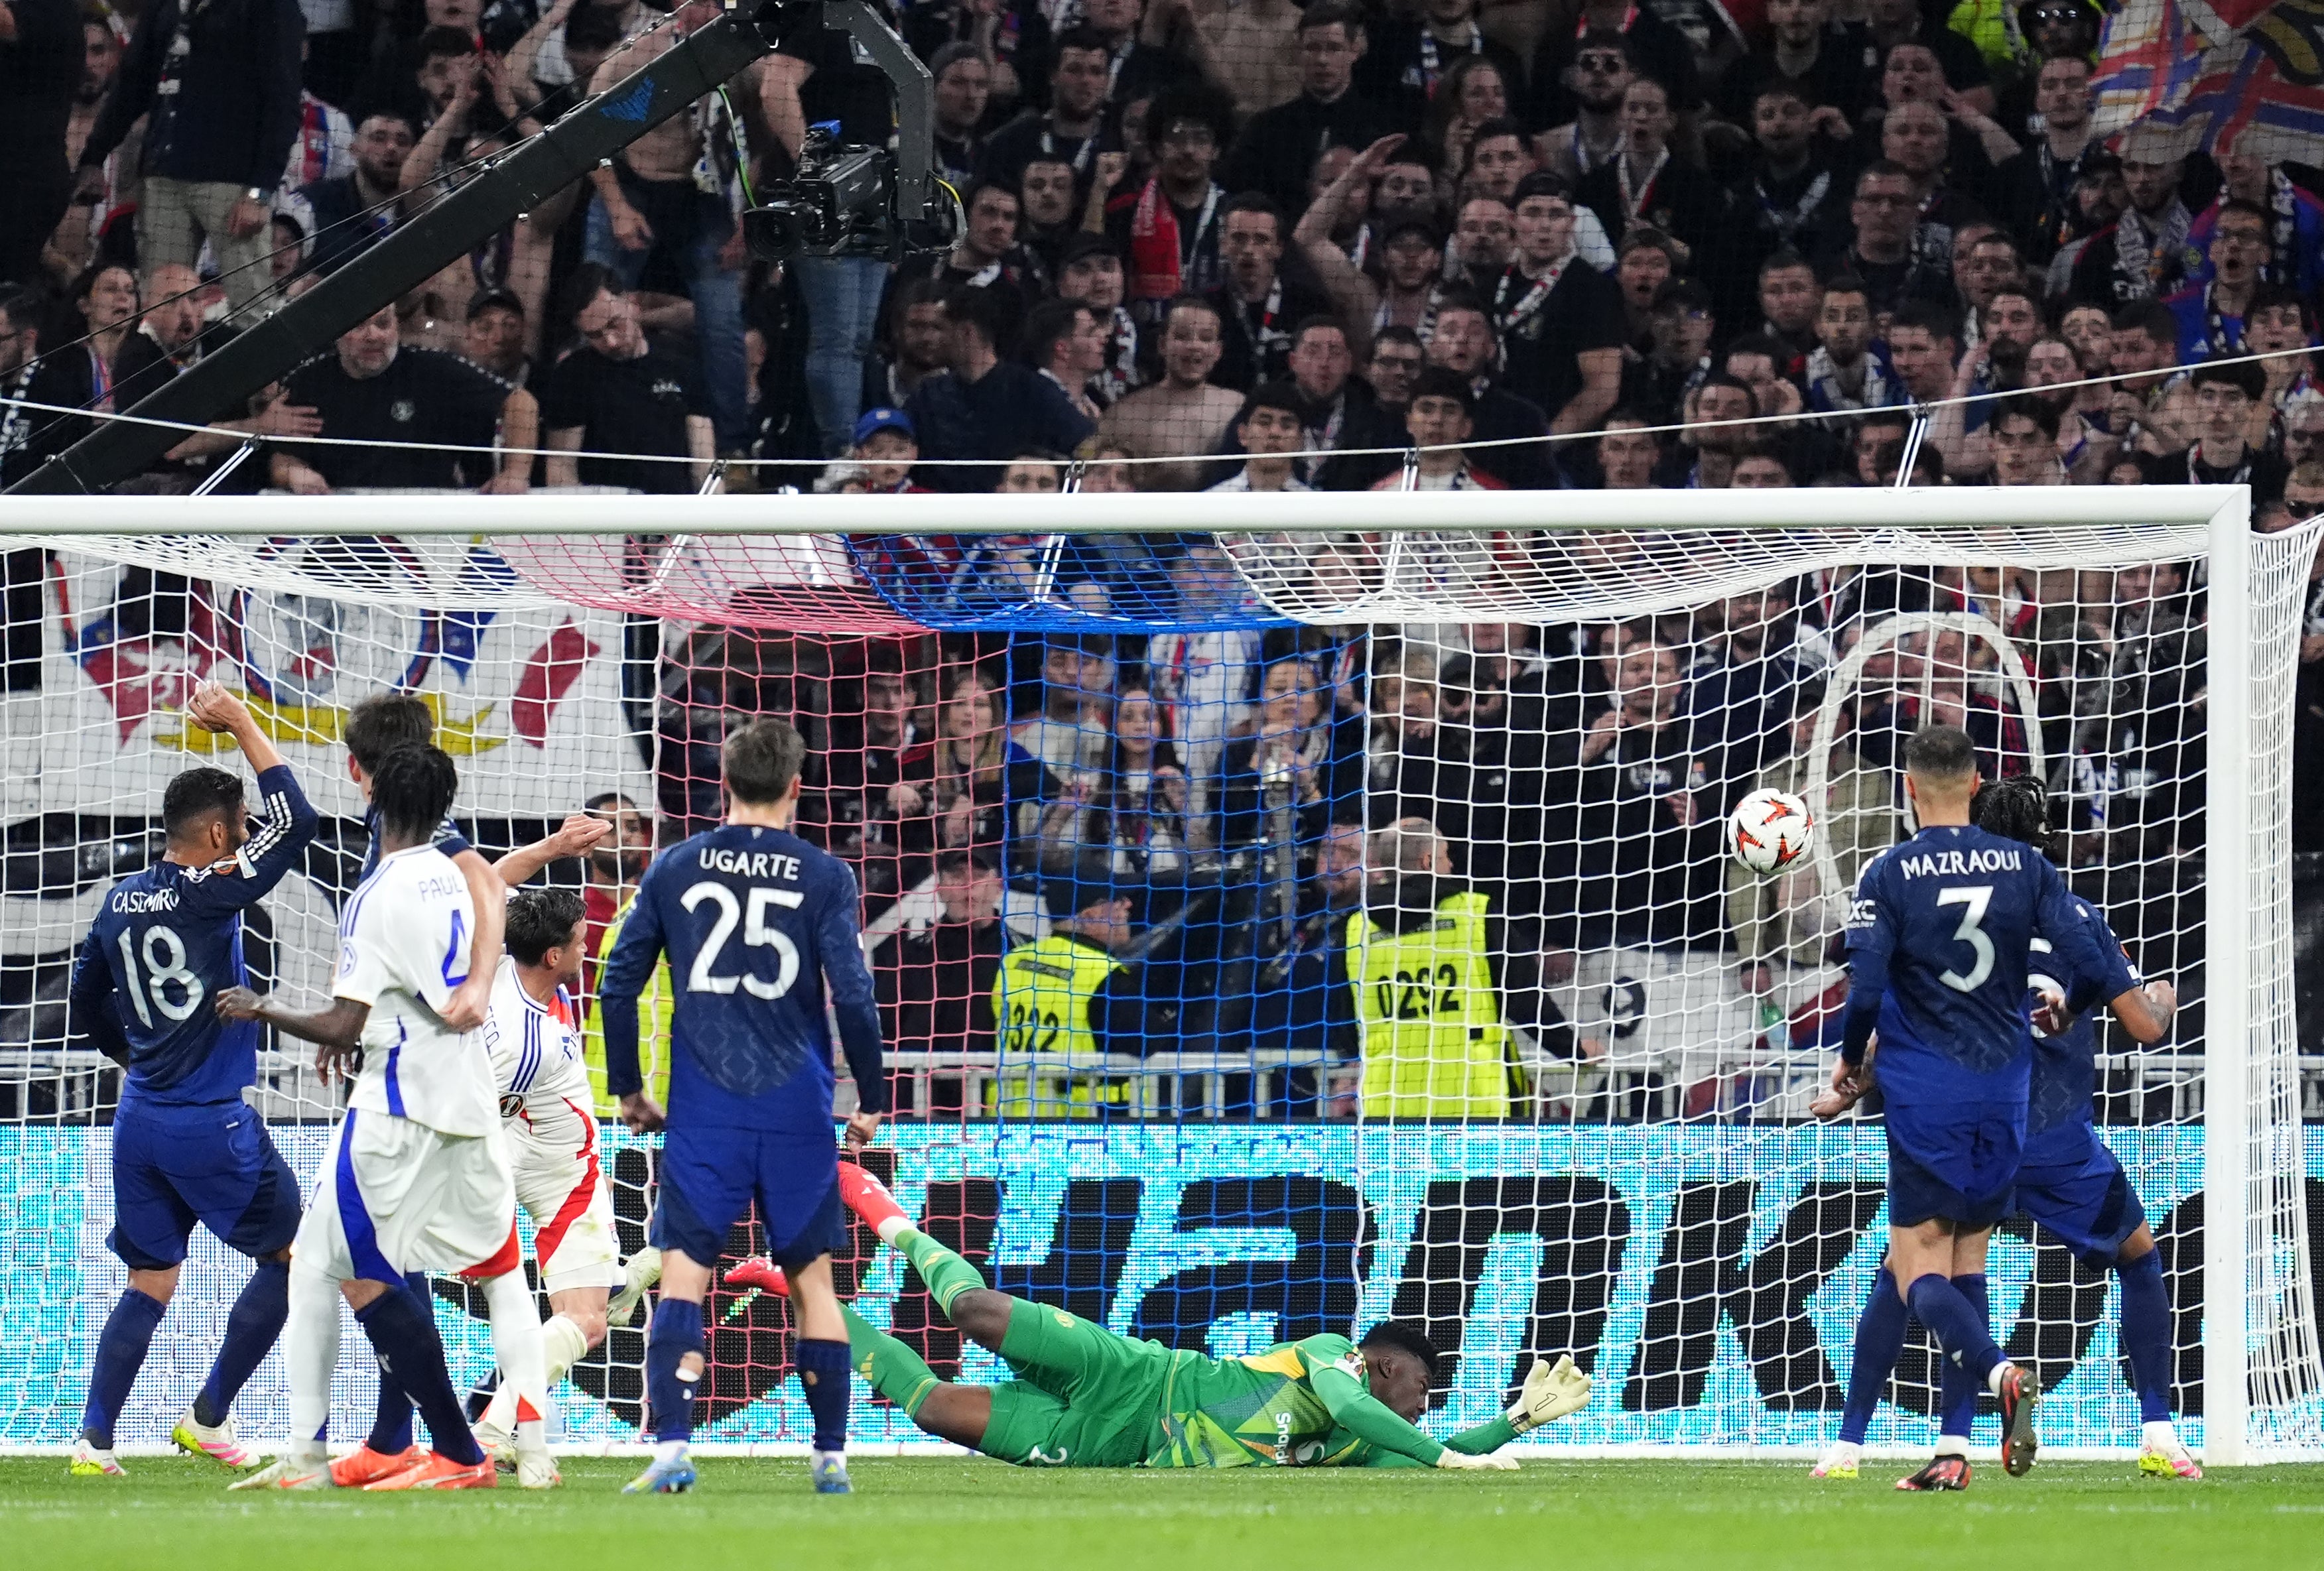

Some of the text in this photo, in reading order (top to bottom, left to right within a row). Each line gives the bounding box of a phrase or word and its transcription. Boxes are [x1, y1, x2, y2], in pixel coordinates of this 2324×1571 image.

[699, 848, 801, 881] UGARTE
[1900, 849, 2022, 881] MAZRAOUI
[112, 888, 180, 914] CASEMIRO
[418, 873, 463, 903] PAUL
[680, 881, 805, 1000] 25
[1936, 885, 1996, 993] 3
[117, 925, 204, 1029] 18
[1378, 964, 1459, 1022] 0292
